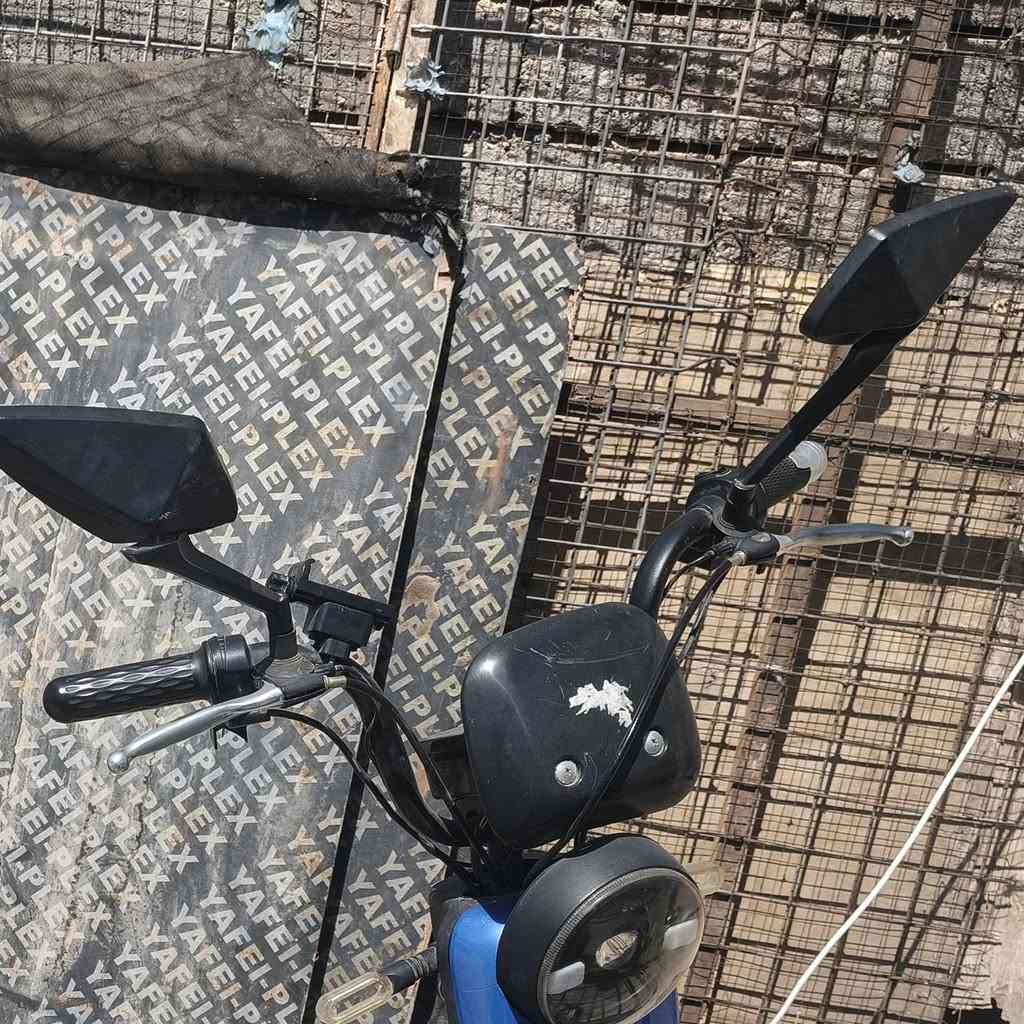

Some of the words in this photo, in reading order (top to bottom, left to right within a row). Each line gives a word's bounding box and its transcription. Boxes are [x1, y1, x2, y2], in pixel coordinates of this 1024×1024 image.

[15, 170, 136, 338] AFEI-PLEX
[70, 186, 167, 315] EI-PLEX
[122, 197, 196, 292] -PLEX
[328, 229, 440, 381] AFEI-PLE
[192, 298, 334, 494] YAFEI-PLEX
[222, 276, 363, 471] YAFEI-PLEX
[252, 253, 394, 448] YAFEI-PLEX
[283, 229, 426, 426] YAFEI-PLEX
[445, 341, 532, 456] I-PLEX
[164, 321, 304, 515] YAFEI-PLEX
[180, 736, 257, 836] -PLEX
[224, 865, 317, 991] YAFEI-P
